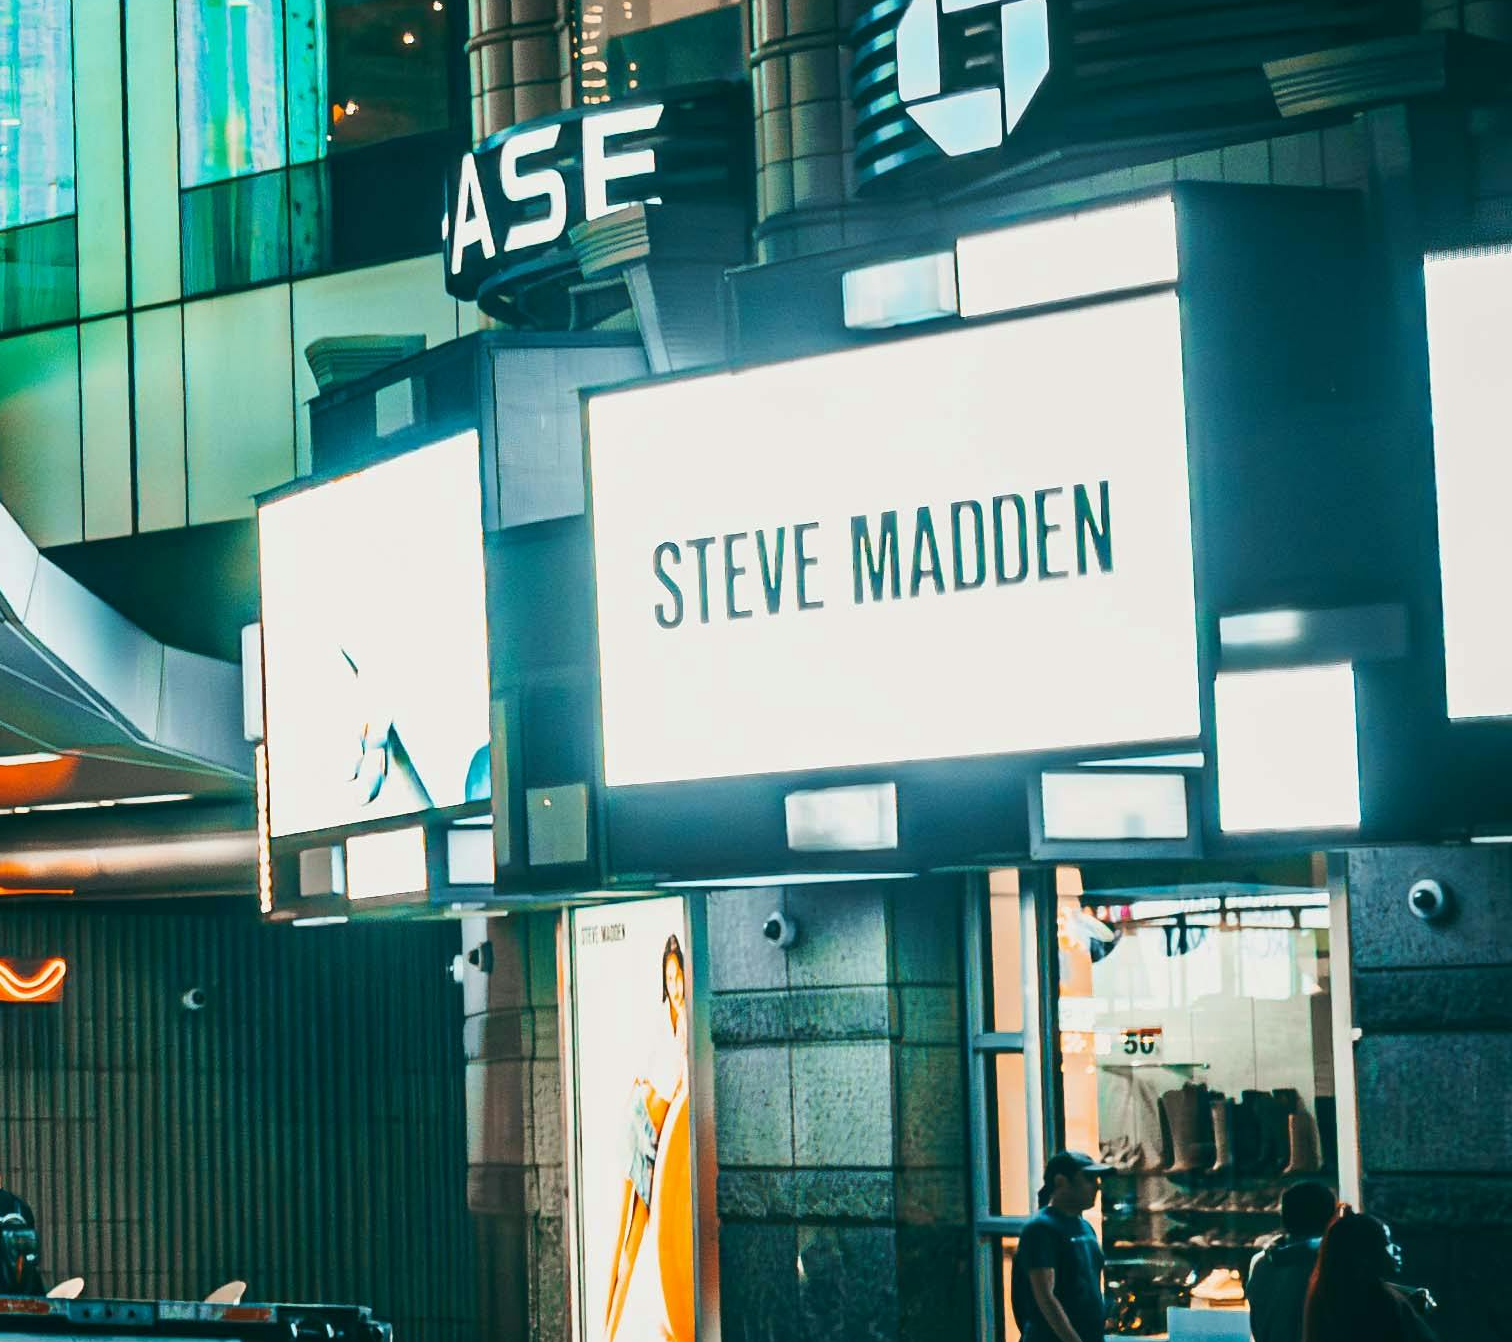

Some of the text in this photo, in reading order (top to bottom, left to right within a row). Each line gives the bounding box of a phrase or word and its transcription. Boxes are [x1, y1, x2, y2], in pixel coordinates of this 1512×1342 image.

[444, 104, 663, 274] ASE
[653, 479, 1114, 629] STEVE MADDEN
